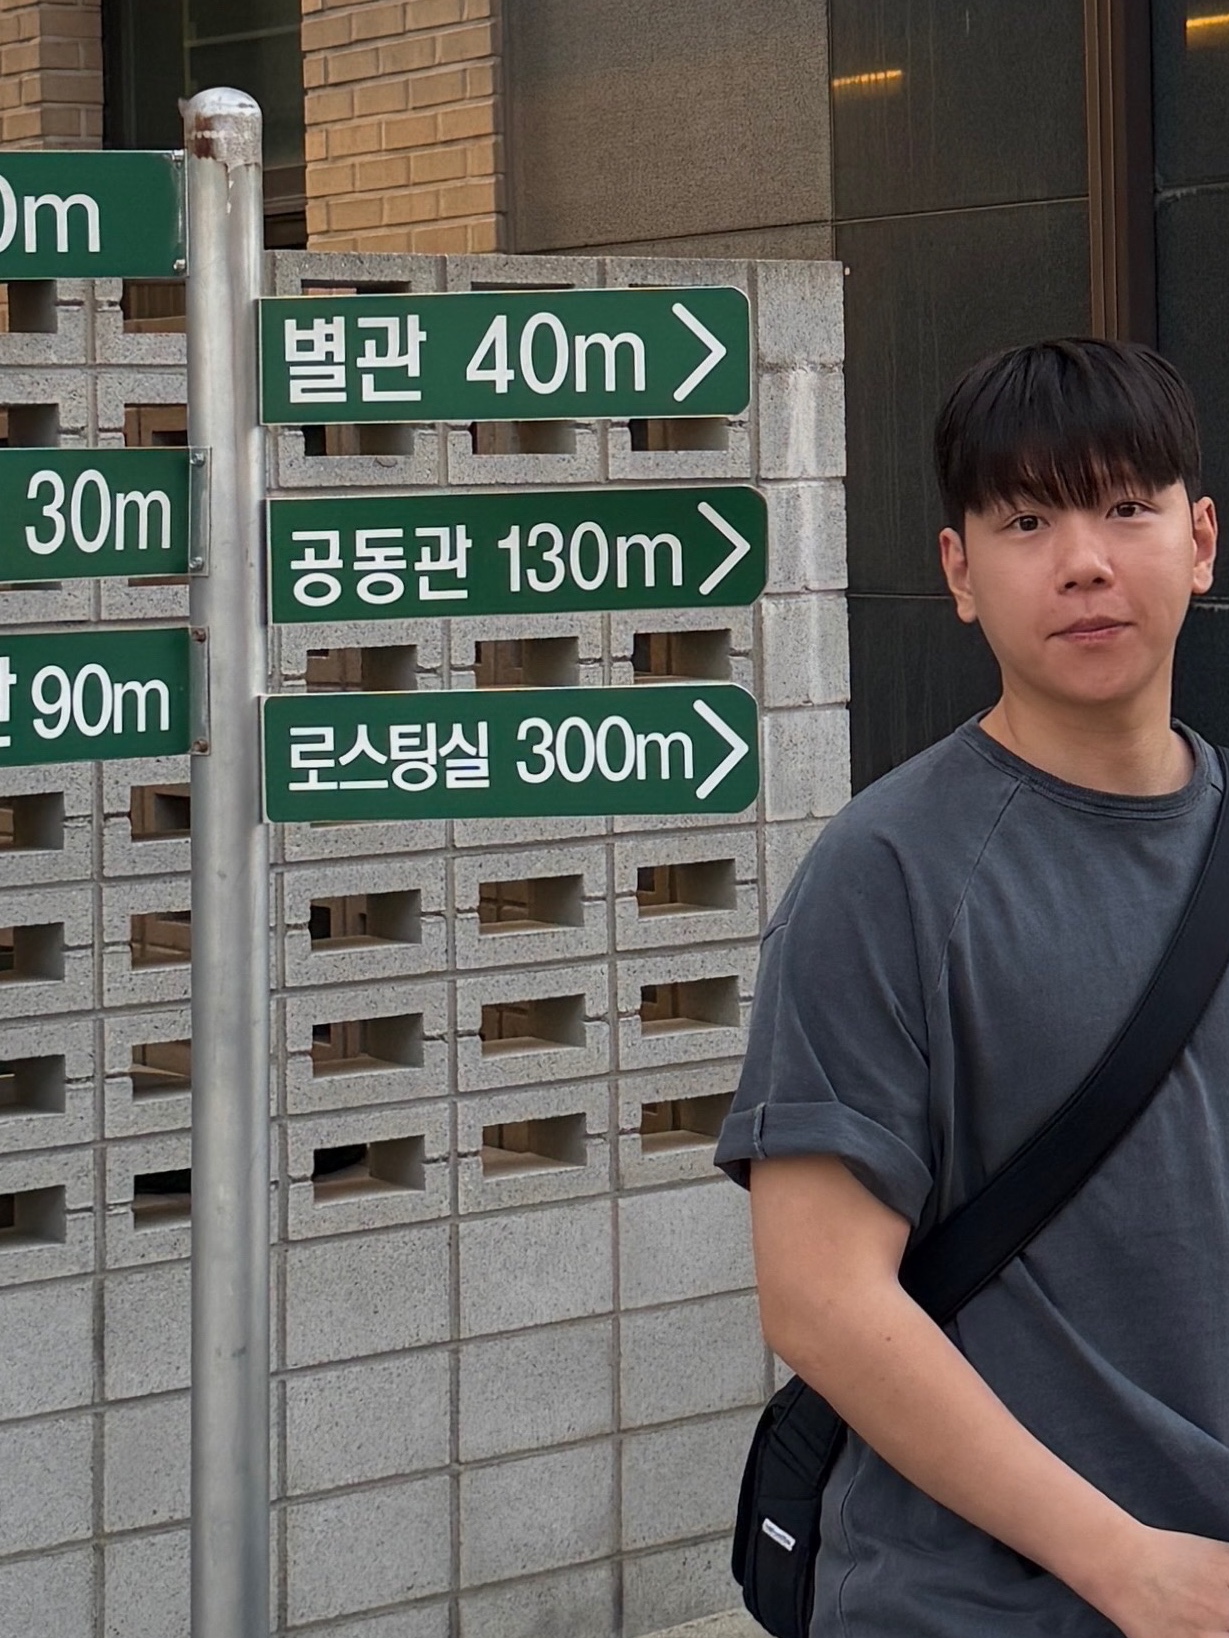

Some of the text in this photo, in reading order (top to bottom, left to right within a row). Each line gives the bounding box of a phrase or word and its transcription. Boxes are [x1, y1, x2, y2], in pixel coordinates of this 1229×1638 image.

[284, 312, 646, 404] 별관 40m
[25, 469, 171, 555] 30m
[290, 521, 683, 607] 공동관 130m
[31, 663, 169, 739] 90m
[288, 715, 695, 792] 로스팅실 300m
